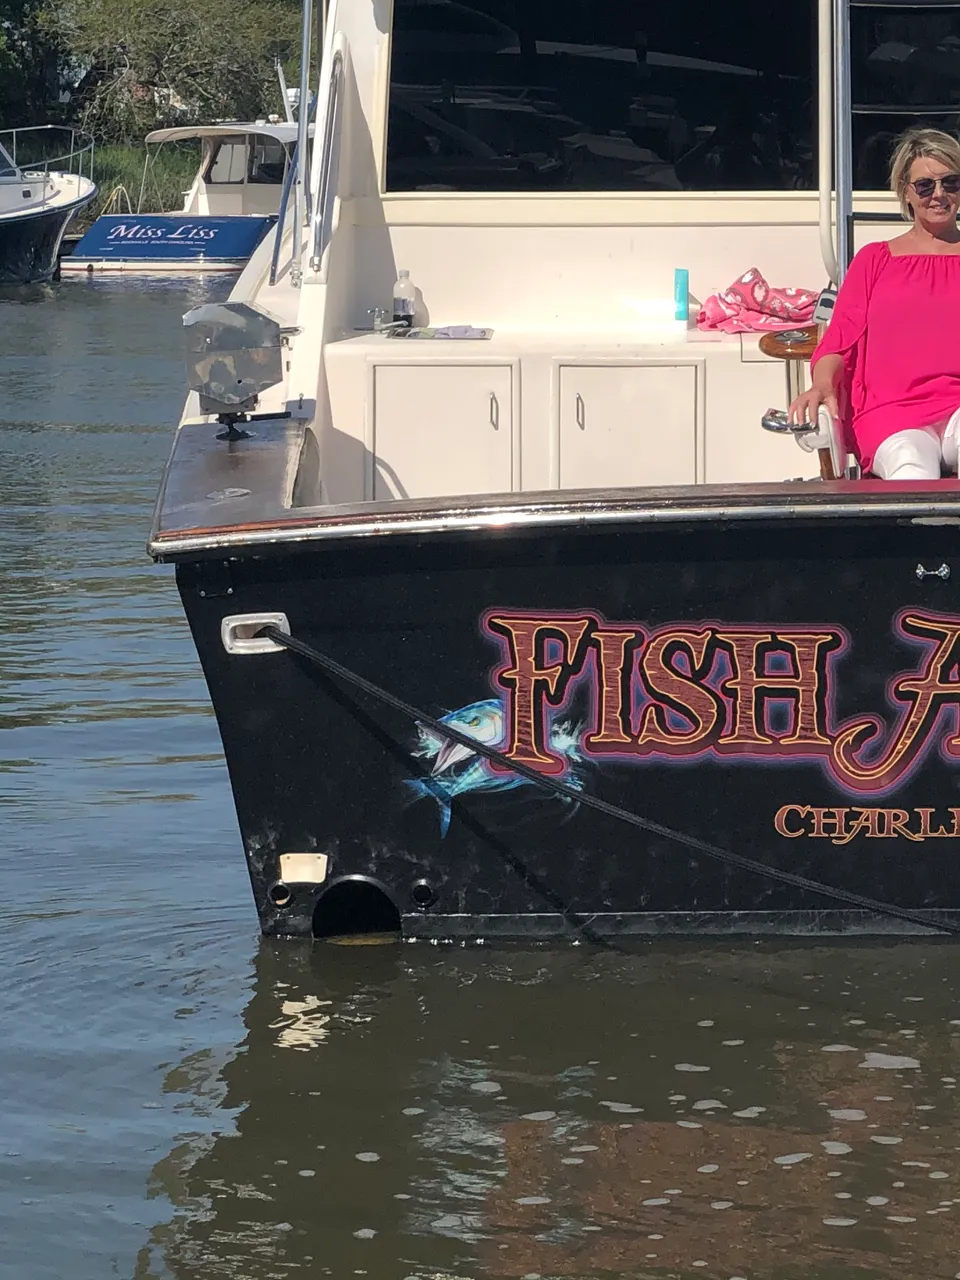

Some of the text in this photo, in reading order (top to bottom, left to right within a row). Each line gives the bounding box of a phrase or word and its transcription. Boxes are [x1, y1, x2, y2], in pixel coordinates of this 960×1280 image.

[106, 224, 219, 240] Miss Liss
[484, 613, 840, 770] FISH
